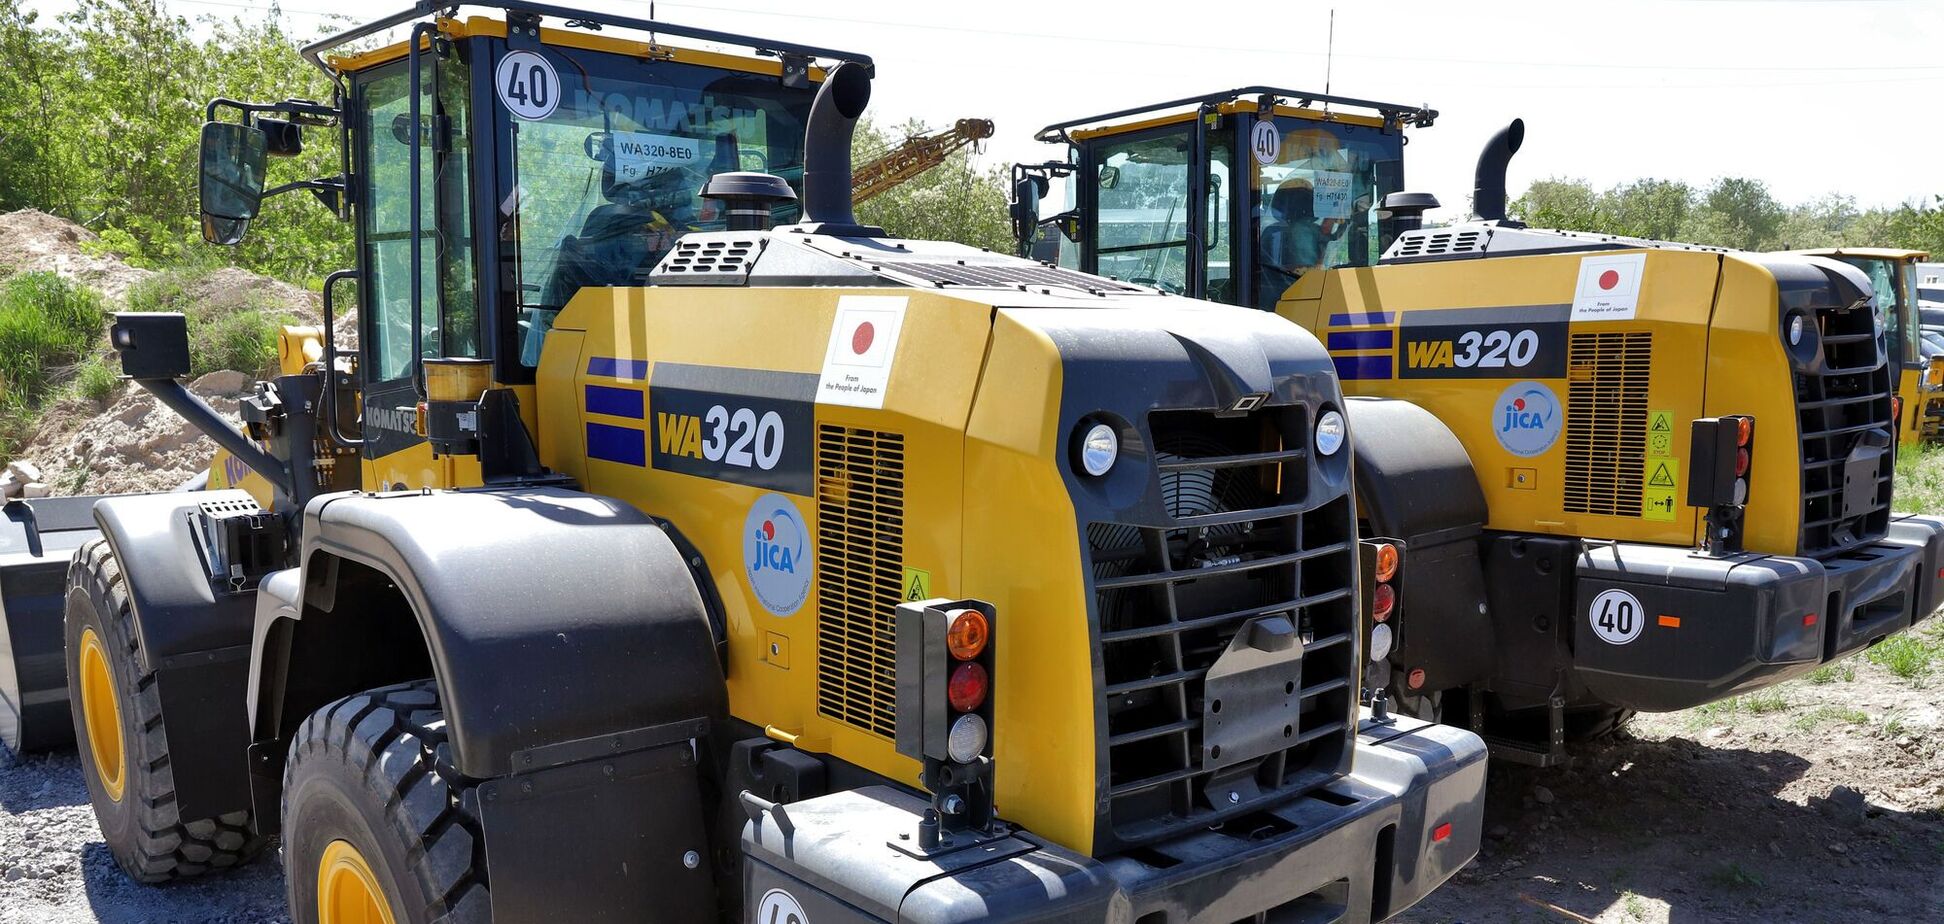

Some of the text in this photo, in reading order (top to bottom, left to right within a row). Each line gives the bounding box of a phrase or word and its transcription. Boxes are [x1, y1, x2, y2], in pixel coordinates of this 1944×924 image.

[508, 62, 548, 108] 40
[574, 89, 768, 142] KOMATSU
[620, 142, 692, 159] WA320-8E0
[1257, 128, 1274, 157] 40
[1407, 329, 1539, 368] WA320
[825, 382, 877, 395] the People of Japan
[845, 374, 859, 382] From
[658, 405, 785, 470] WA320
[1598, 599, 1633, 634] 40
